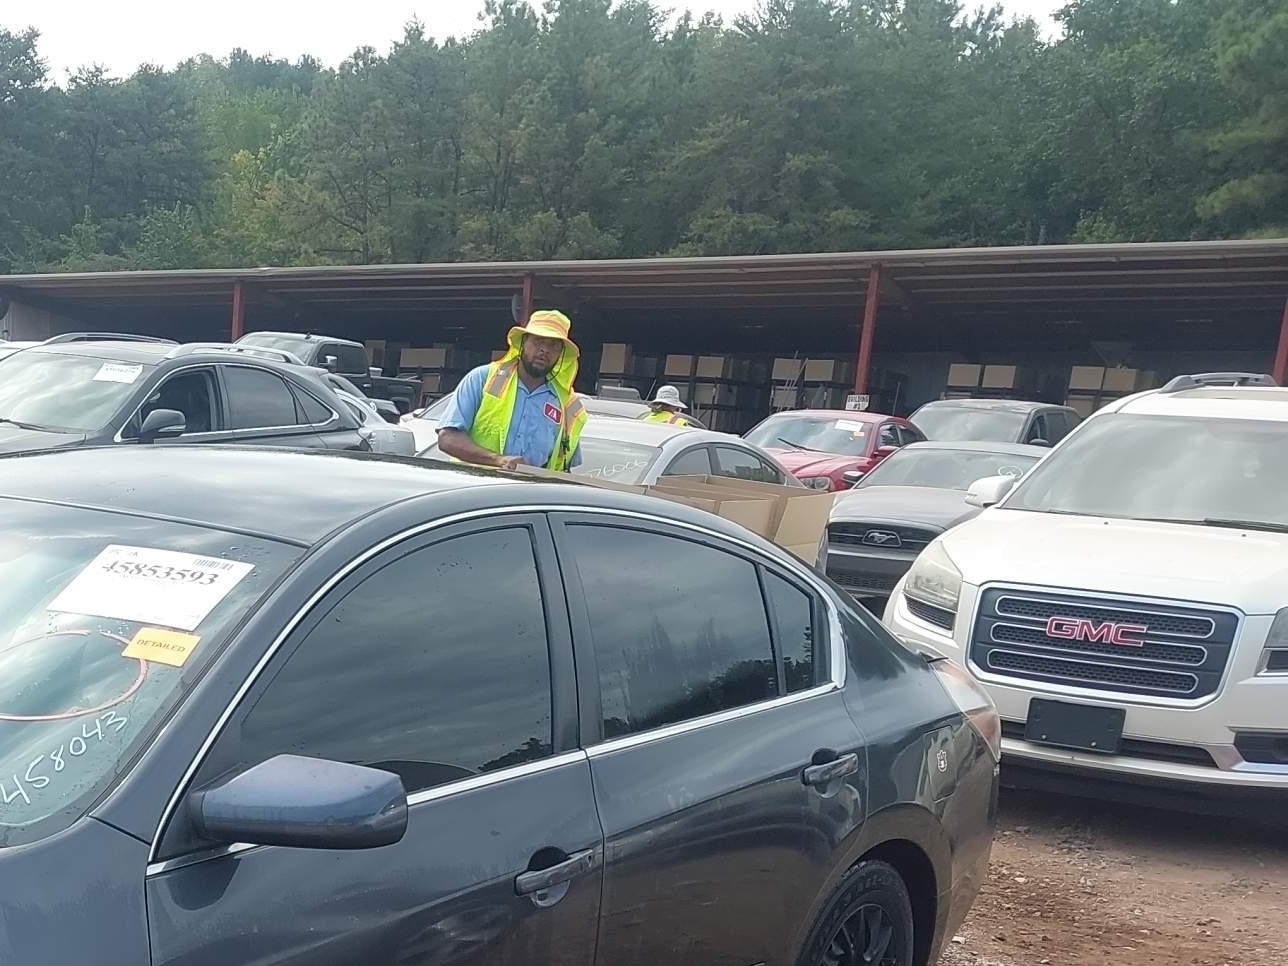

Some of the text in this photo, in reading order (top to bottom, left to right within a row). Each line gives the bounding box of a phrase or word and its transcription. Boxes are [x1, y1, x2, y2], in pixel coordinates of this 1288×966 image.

[101, 560, 219, 585] 45853593
[1046, 616, 1148, 647] GMC
[136, 639, 186, 653] DETAILED
